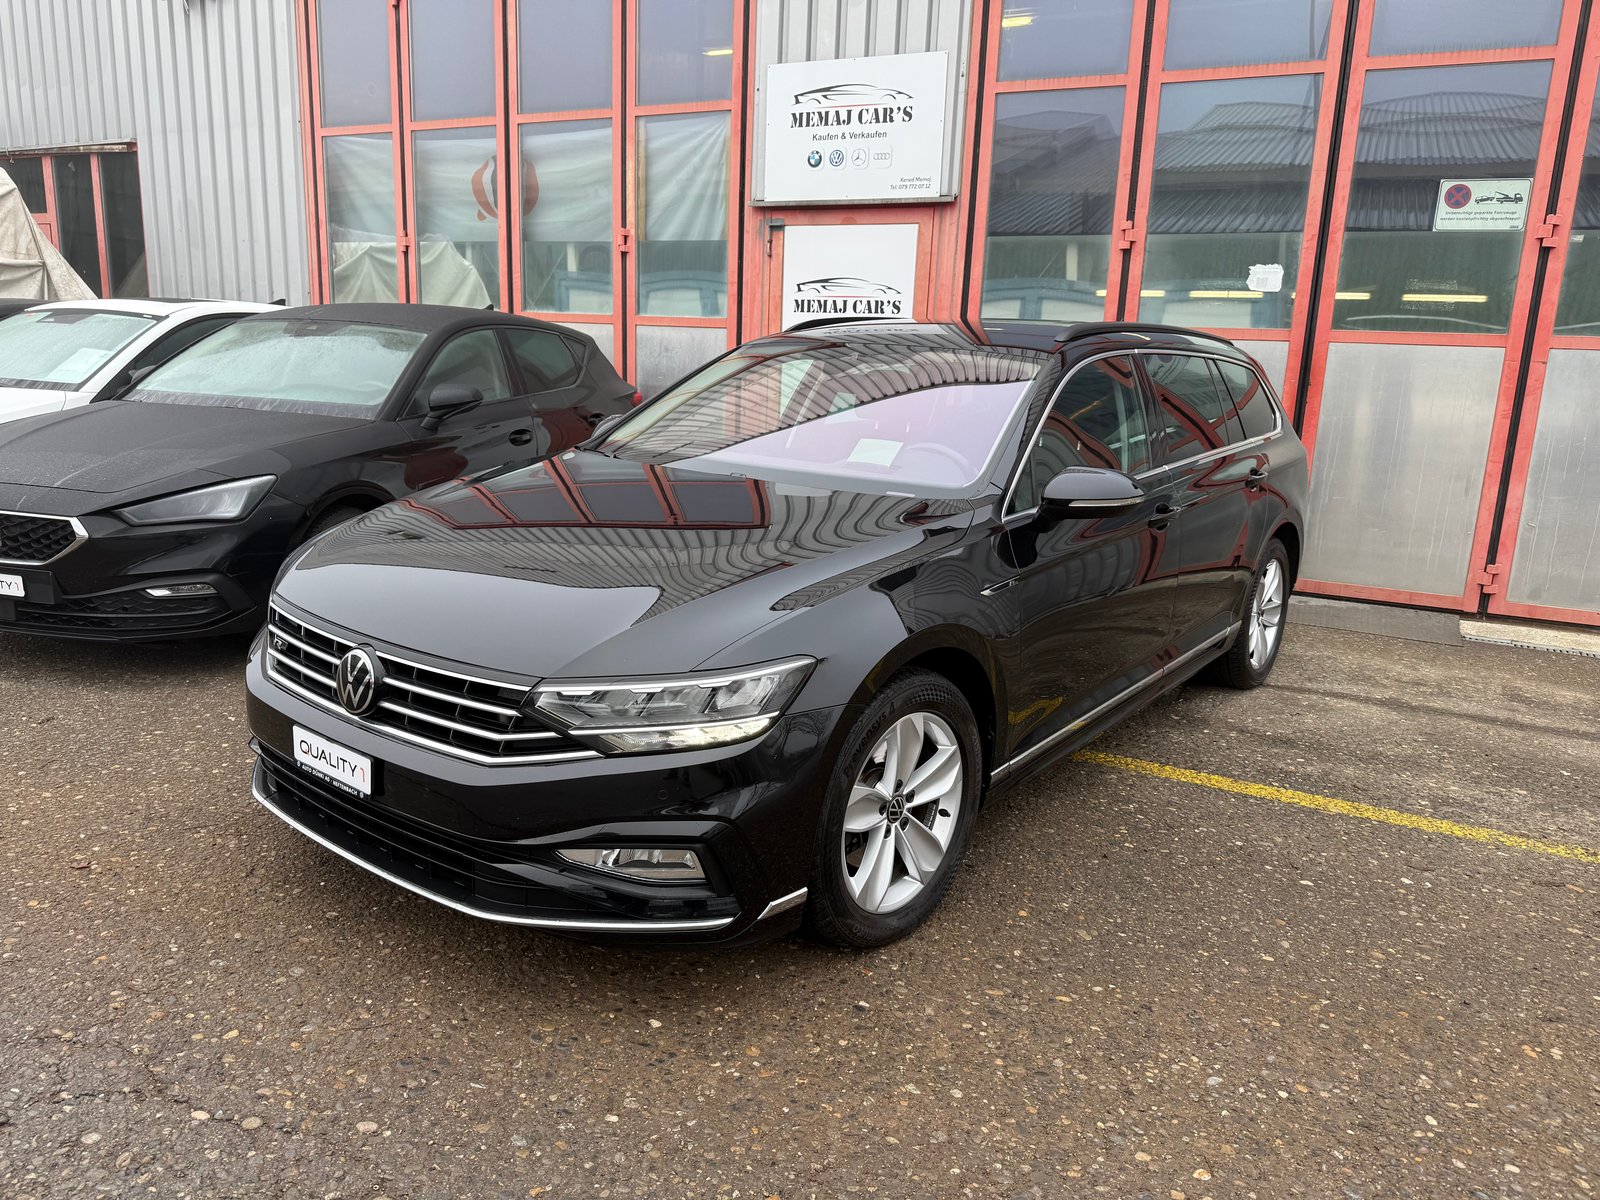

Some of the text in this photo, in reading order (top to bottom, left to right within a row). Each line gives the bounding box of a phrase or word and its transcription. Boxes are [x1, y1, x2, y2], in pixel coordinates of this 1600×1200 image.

[790, 105, 913, 128] MEMAJ CAR'S
[812, 132, 839, 141] Kaufen
[849, 130, 887, 140] Verkaufen
[793, 299, 901, 314] MEMAJ CAR'S
[302, 764, 312, 773] AUTO
